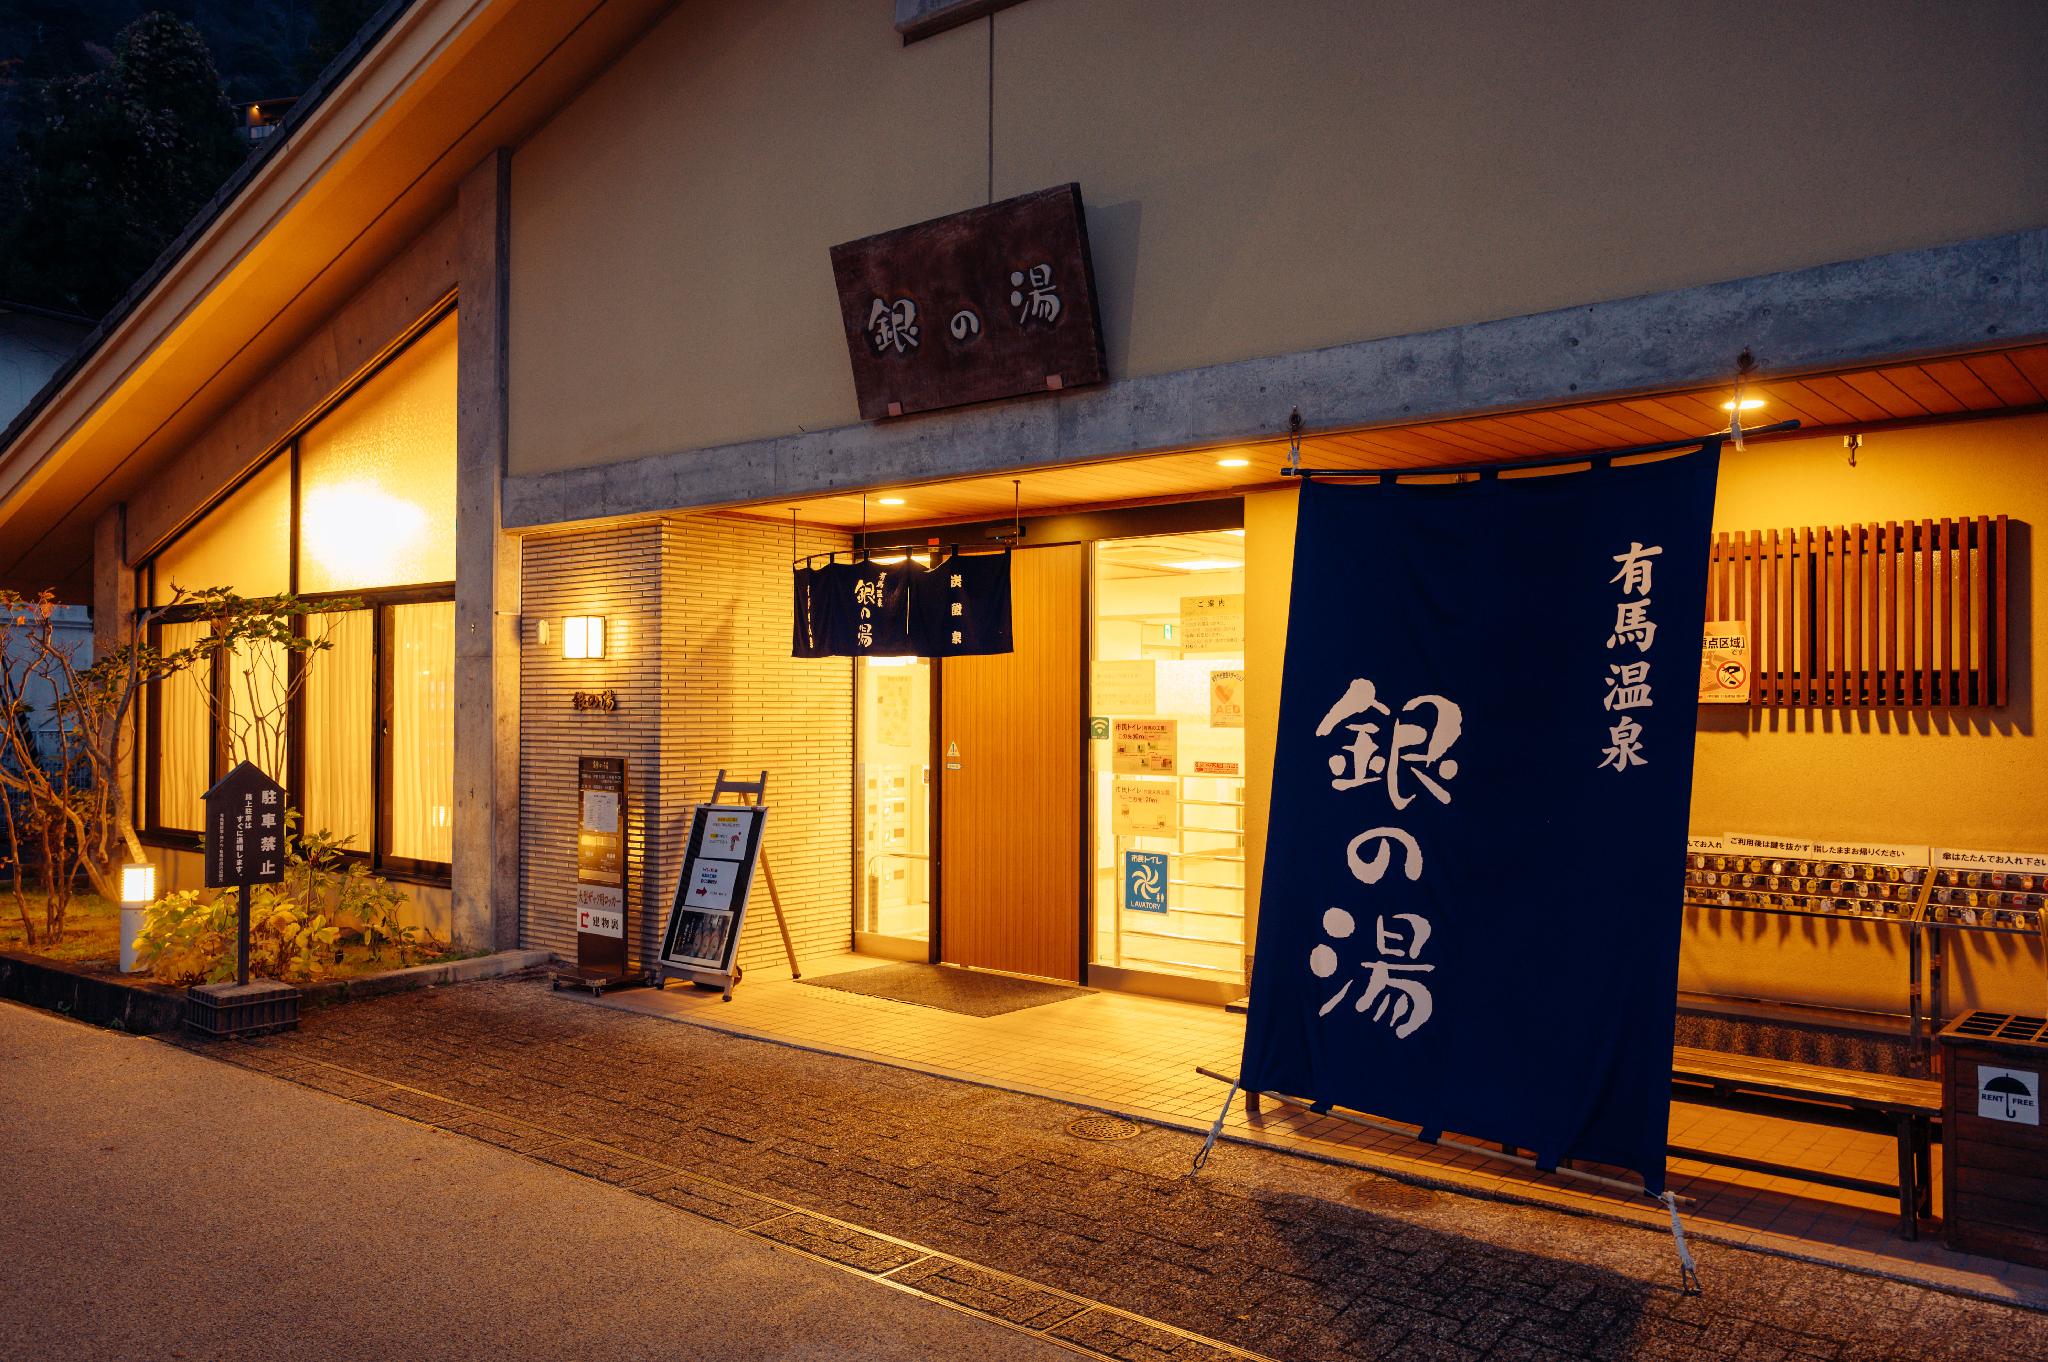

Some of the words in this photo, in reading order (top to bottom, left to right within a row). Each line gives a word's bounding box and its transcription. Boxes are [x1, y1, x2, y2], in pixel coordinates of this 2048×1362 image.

[867, 263, 1062, 353] 銀の湯
[854, 579, 876, 648] 銀の湯
[950, 574, 962, 645] 炭酸泉
[1597, 542, 1663, 772] 有馬温泉
[572, 689, 616, 711] 銀の湯
[1216, 704, 1240, 714] AED
[235, 815, 244, 877] すぐに通報します。
[260, 789, 277, 875] 駐車禁止
[1730, 837, 1810, 852] ご利用後は鍵を抜かず
[1131, 854, 1162, 865] 市民トイレ
[1310, 678, 1462, 1039] 銀の湯
[592, 916, 619, 930] 建物裏
[1130, 900, 1161, 910] LAVATORY
[1981, 1093, 2004, 1102] RENT
[2012, 1098, 2035, 1107] FREE
